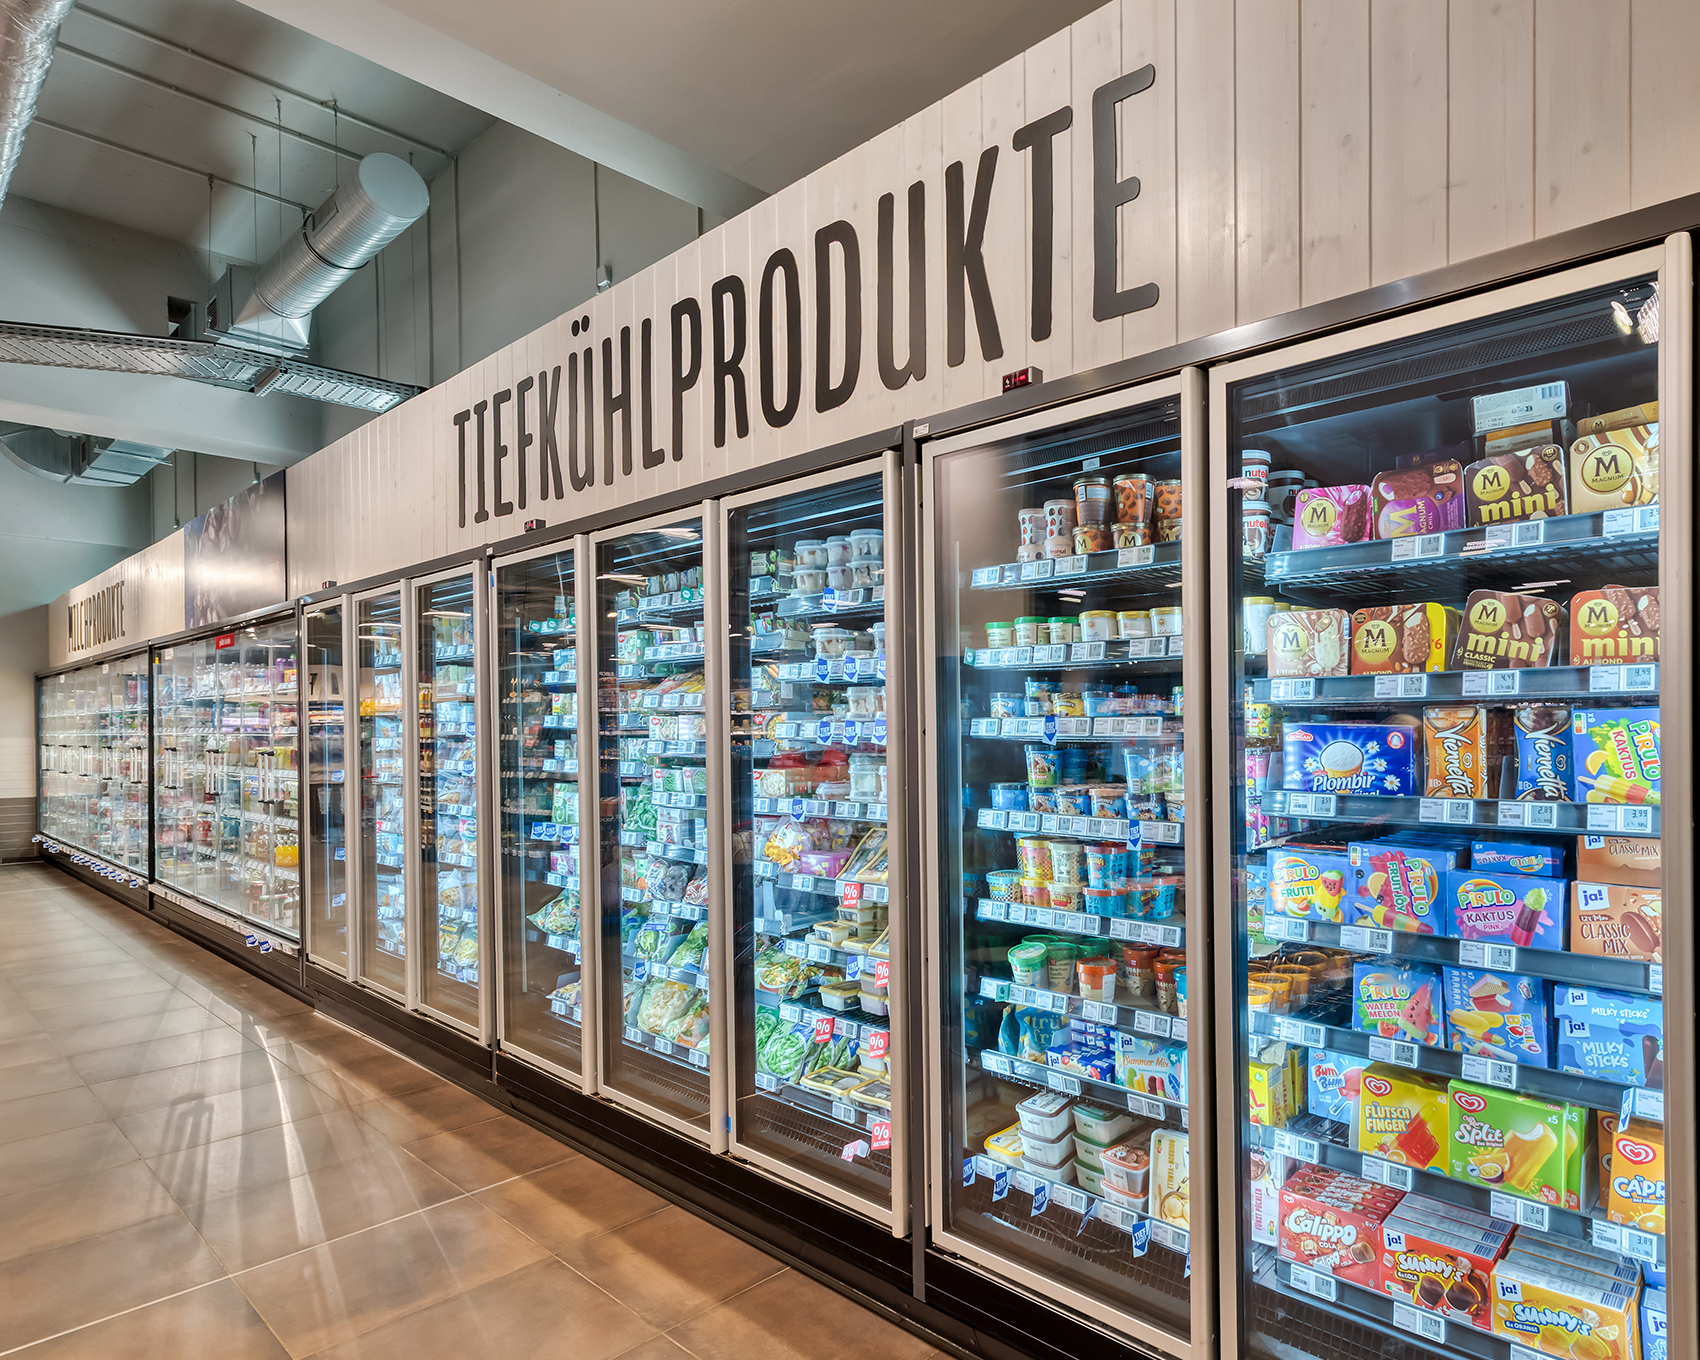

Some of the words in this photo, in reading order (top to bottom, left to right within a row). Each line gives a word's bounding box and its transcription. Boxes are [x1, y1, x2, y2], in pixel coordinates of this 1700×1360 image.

[453, 63, 1160, 529] TIEFKÜHLPRODUKTE
[1591, 473, 1625, 484] MAGNUM
[1479, 483, 1557, 523] mini
[1417, 500, 1427, 534] AGNUM
[1467, 631, 1544, 662] mini
[1581, 630, 1660, 657] min
[1464, 651, 1497, 663] CLASSIC
[1435, 721, 1476, 796] Viennetta
[1526, 722, 1569, 798] Viennetta
[1611, 730, 1637, 780] KAKTUS
[1312, 773, 1376, 792] Plombir
[1632, 809, 1648, 818] 3.99
[1477, 855, 1507, 864] KAKTUS
[1388, 861, 1402, 891] FRUIT
[845, 885, 857, 899] %
[1582, 890, 1604, 907] ja!
[1392, 891, 1408, 914] JOY
[1466, 910, 1515, 923] KAKTUS
[1483, 923, 1501, 931] PINK
[1571, 992, 1584, 1003] ja!
[1365, 1002, 1396, 1011] WATER
[1591, 1006, 1618, 1017] MILKY
[1619, 1008, 1649, 1019] STICKS
[1369, 1009, 1400, 1019] MELON
[816, 1020, 830, 1034] %
[1568, 1020, 1586, 1034] ja!
[816, 1033, 830, 1041] AKTION
[869, 1035, 884, 1050] %
[1121, 1036, 1133, 1048] ja!
[1582, 1041, 1624, 1056] MILKY
[1050, 1055, 1060, 1067] ja!
[1122, 1054, 1154, 1067] Summer
[1585, 1054, 1629, 1068] STICKS
[1314, 1064, 1338, 1078] Bum
[1318, 1076, 1343, 1089] Bum
[1364, 1104, 1412, 1121] FLUTSCH
[1366, 1118, 1409, 1134] FINGER
[1547, 1115, 1559, 1125] x5
[873, 1124, 889, 1140] %
[1454, 1123, 1504, 1145] Split
[1134, 1227, 1146, 1240] TIEF
[1288, 1210, 1357, 1246] Calippo
[1318, 1241, 1337, 1249] COLA
[1386, 1233, 1402, 1247] ja!
[1637, 1235, 1653, 1246] 3.89
[1398, 1254, 1464, 1282] SUNNY'S
[1500, 1282, 1518, 1297] ja!
[1514, 1304, 1591, 1336] SUNNY'S
